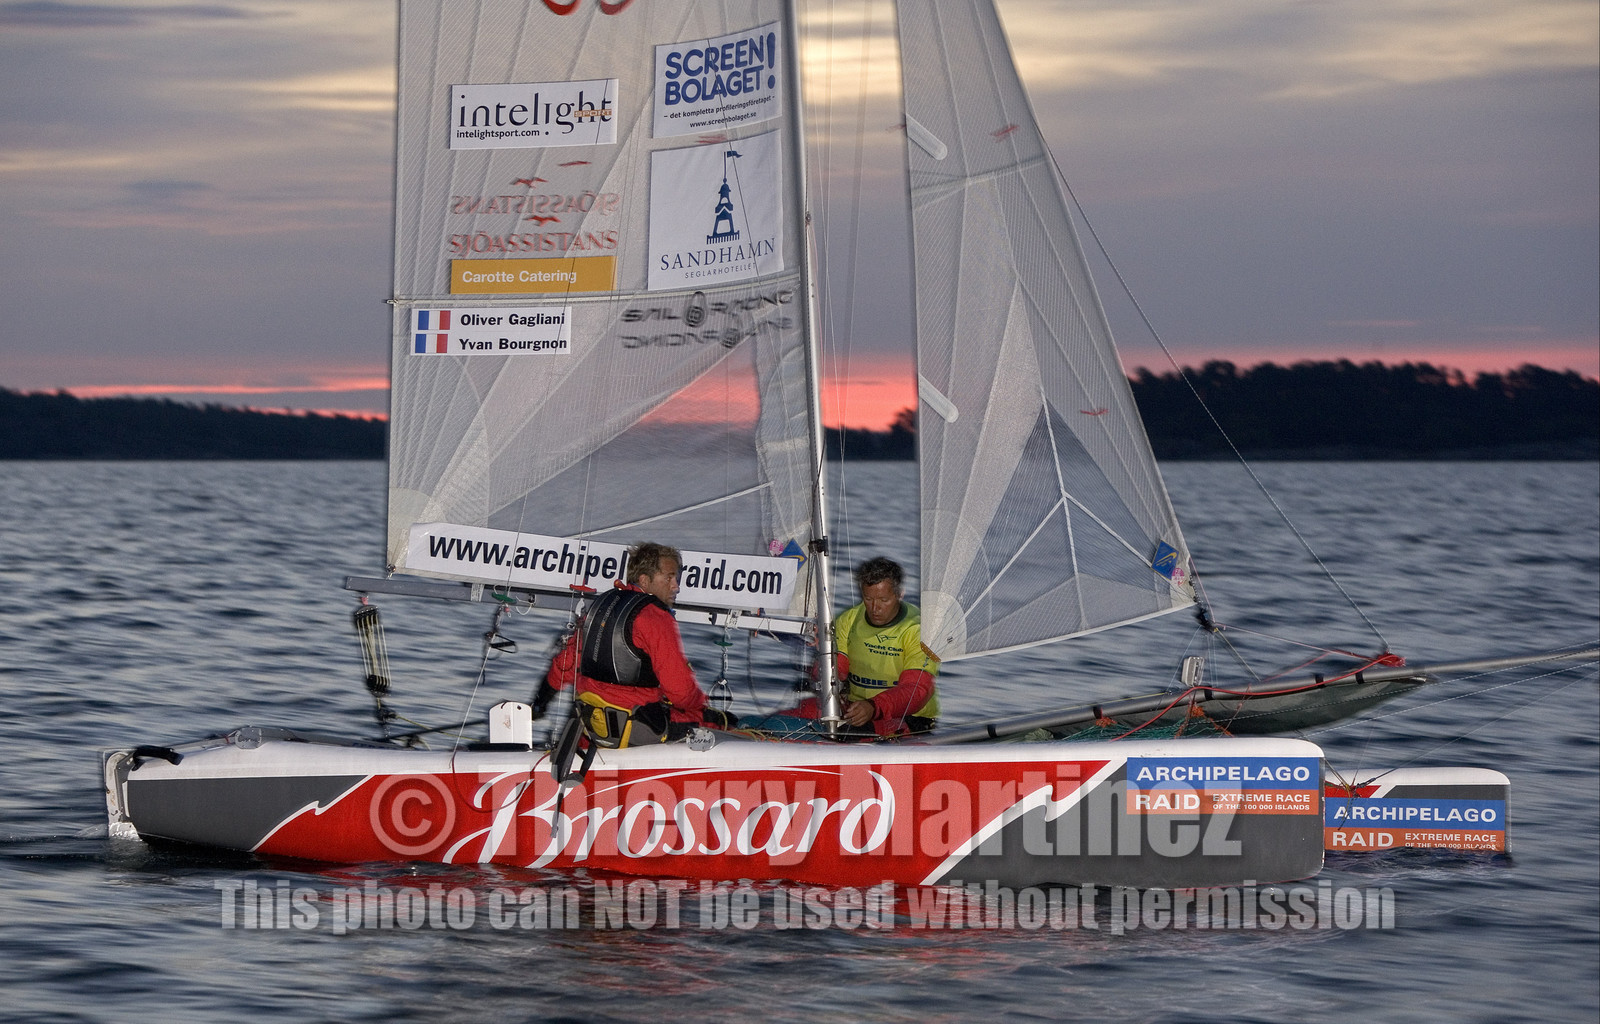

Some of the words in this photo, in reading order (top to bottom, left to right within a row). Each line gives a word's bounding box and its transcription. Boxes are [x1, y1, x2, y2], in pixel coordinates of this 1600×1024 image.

[669, 111, 681, 119] det
[682, 108, 714, 118] kompletta
[689, 111, 757, 128] www.screenbolaget.se
[456, 129, 540, 140] intelightsport.com
[450, 231, 618, 257] SJÖASSISTANS
[660, 238, 776, 271] SANDHAMN
[462, 270, 514, 283] Carotte
[519, 270, 577, 284] Catering
[685, 262, 756, 279] SEGLARHOTELLET
[460, 314, 503, 326] Oliver
[509, 313, 565, 327] Gagliani
[459, 338, 493, 350] Yvan
[498, 338, 567, 351] Bourgnon
[429, 535, 783, 596] www.archipelraid.com
[864, 642, 885, 650] Yacht
[869, 649, 900, 657] Toulon
[1136, 766, 1310, 782] ARCHIPELAGO
[1135, 794, 1201, 810] RAID
[1212, 794, 1272, 802] EXTREME
[1276, 794, 1310, 802] RACE
[441, 770, 895, 869] Brossard
[1334, 806, 1497, 822] ARCHIPELAGO
[1332, 832, 1394, 847] RAID
[1405, 833, 1461, 841] EXTREME
[1464, 834, 1496, 842] RACE
